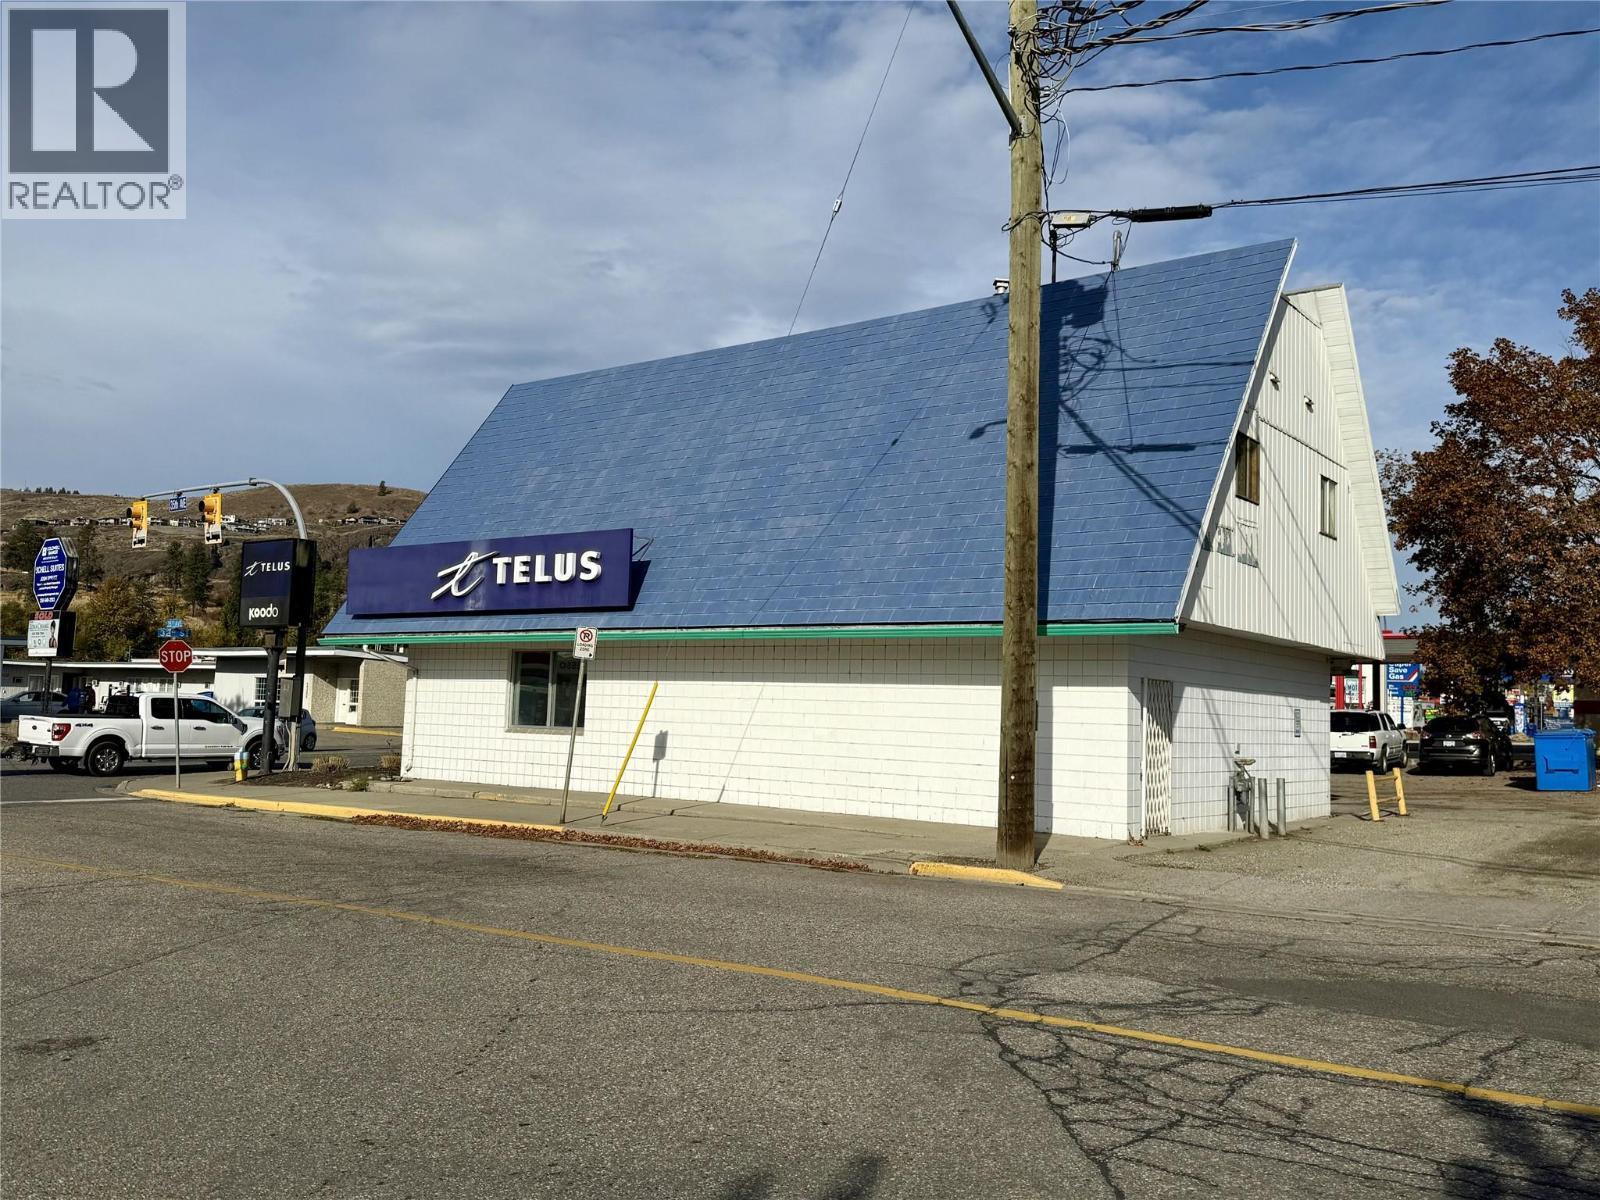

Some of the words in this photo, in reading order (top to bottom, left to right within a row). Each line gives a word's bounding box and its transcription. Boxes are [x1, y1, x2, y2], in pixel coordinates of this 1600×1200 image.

[261, 561, 291, 572] TELUS
[493, 550, 602, 584] TELUS
[249, 603, 279, 621] koodo
[161, 650, 191, 663] STOP
